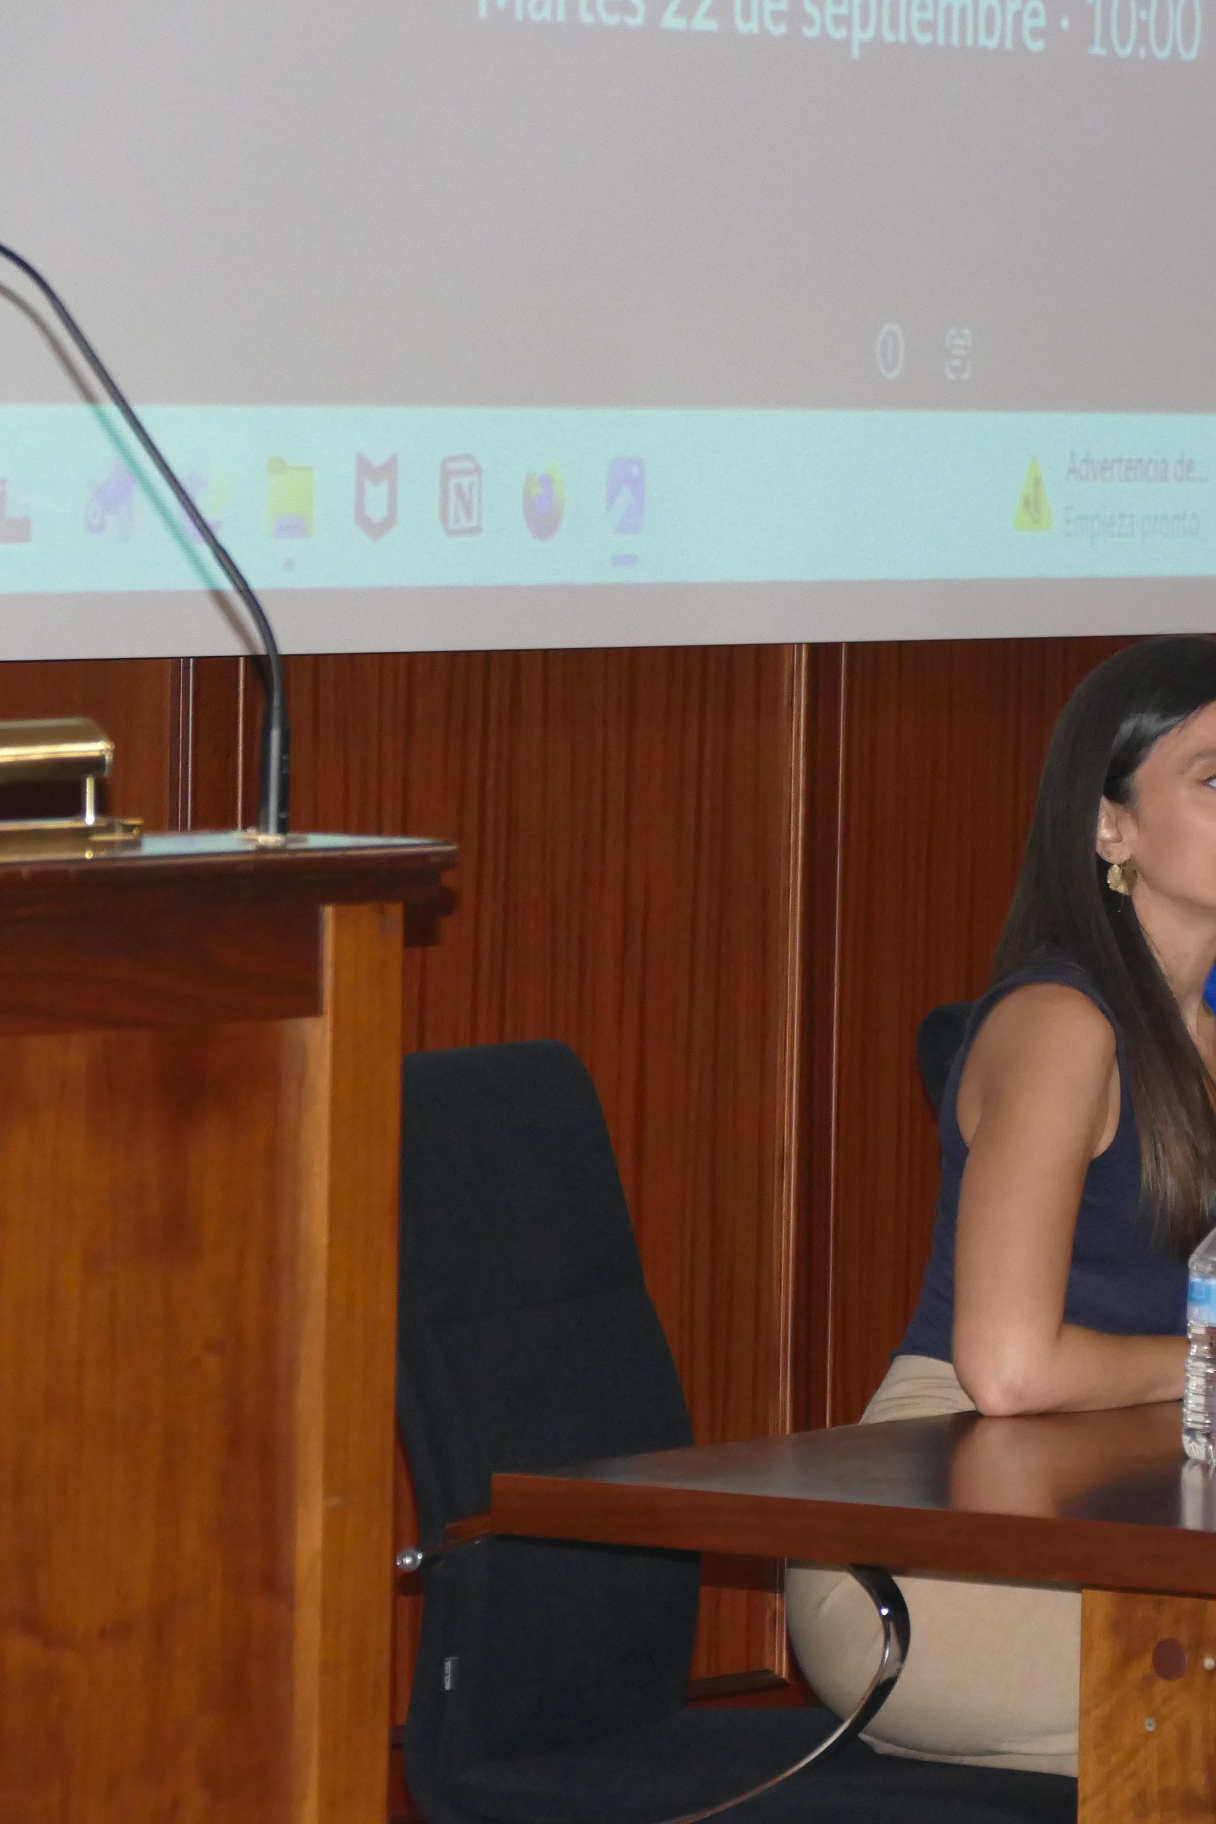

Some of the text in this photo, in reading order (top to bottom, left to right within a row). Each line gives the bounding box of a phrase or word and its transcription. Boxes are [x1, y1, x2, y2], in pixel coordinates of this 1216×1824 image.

[801, 0, 1046, 58] septiembre
[1088, 0, 1201, 60] 10:00
[1066, 449, 1169, 483] Advertencia
